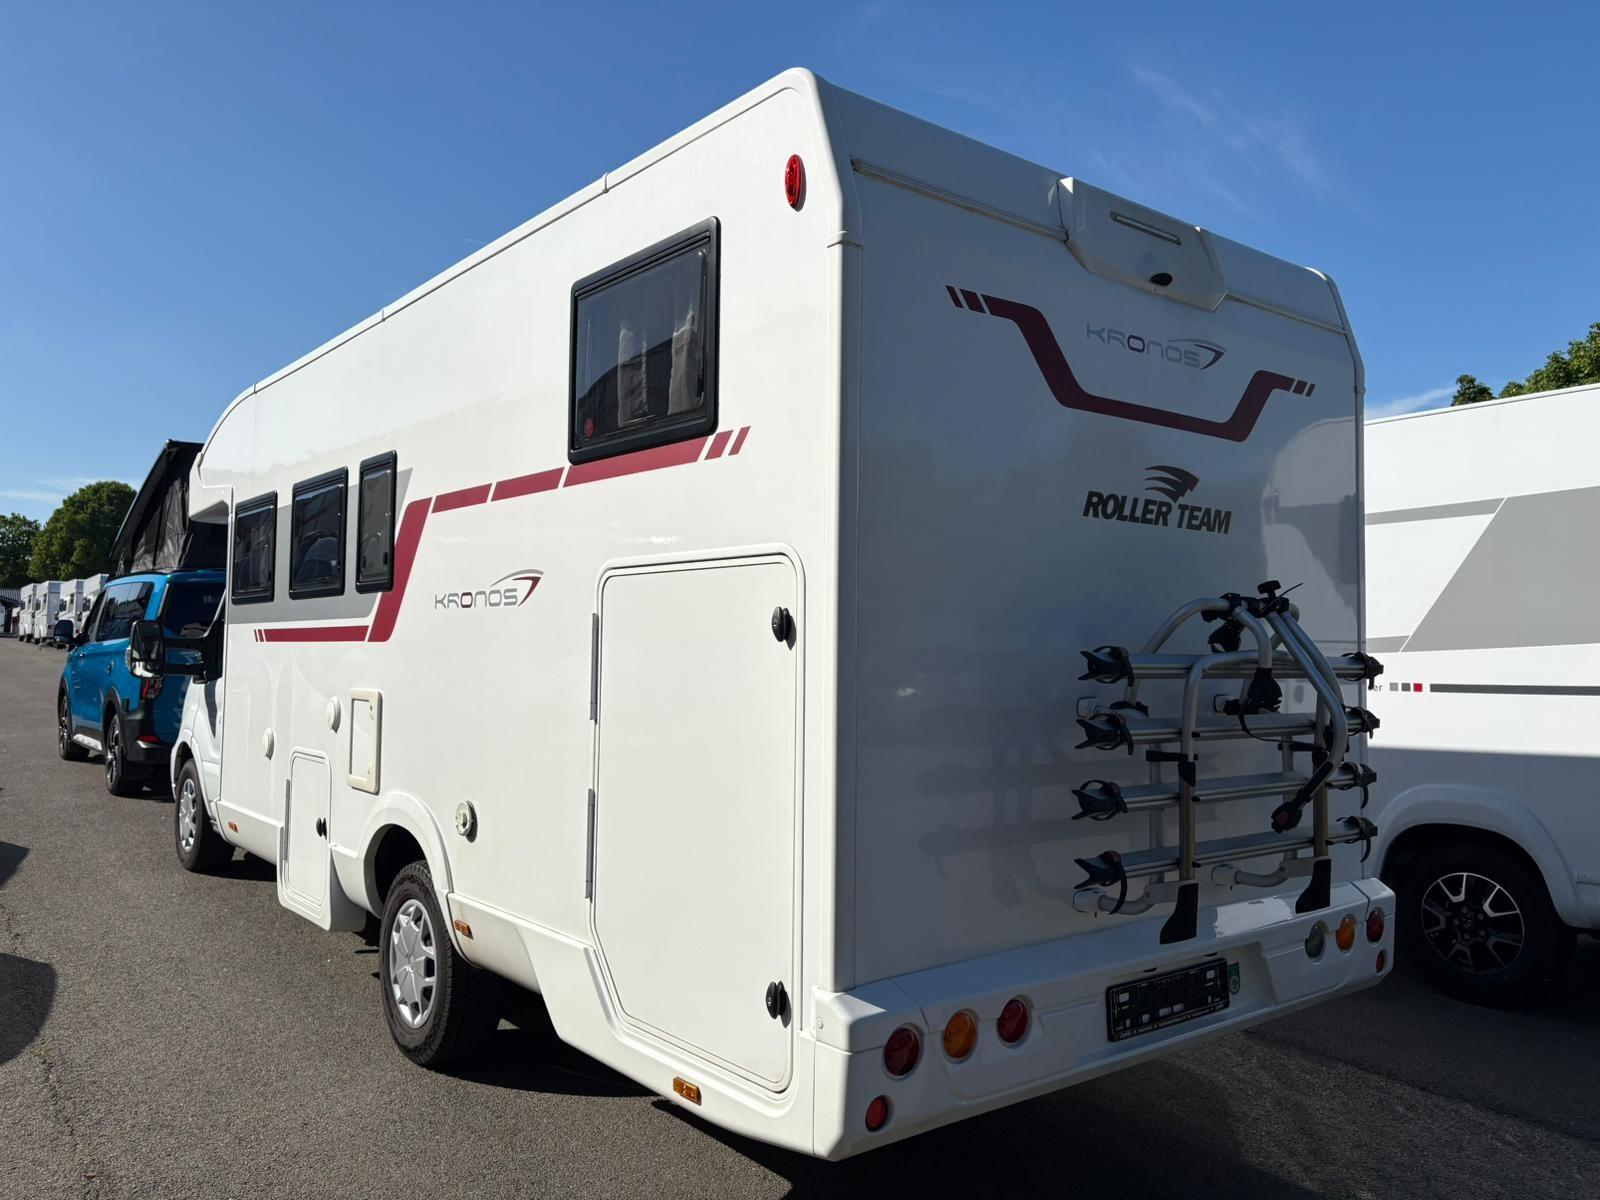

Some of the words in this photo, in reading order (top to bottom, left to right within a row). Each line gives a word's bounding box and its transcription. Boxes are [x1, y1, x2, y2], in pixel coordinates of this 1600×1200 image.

[1086, 322, 1201, 368] KRONOS
[1082, 490, 1173, 527] ROLLER
[1176, 503, 1232, 534] TEAM
[434, 587, 518, 609] KRONOS
